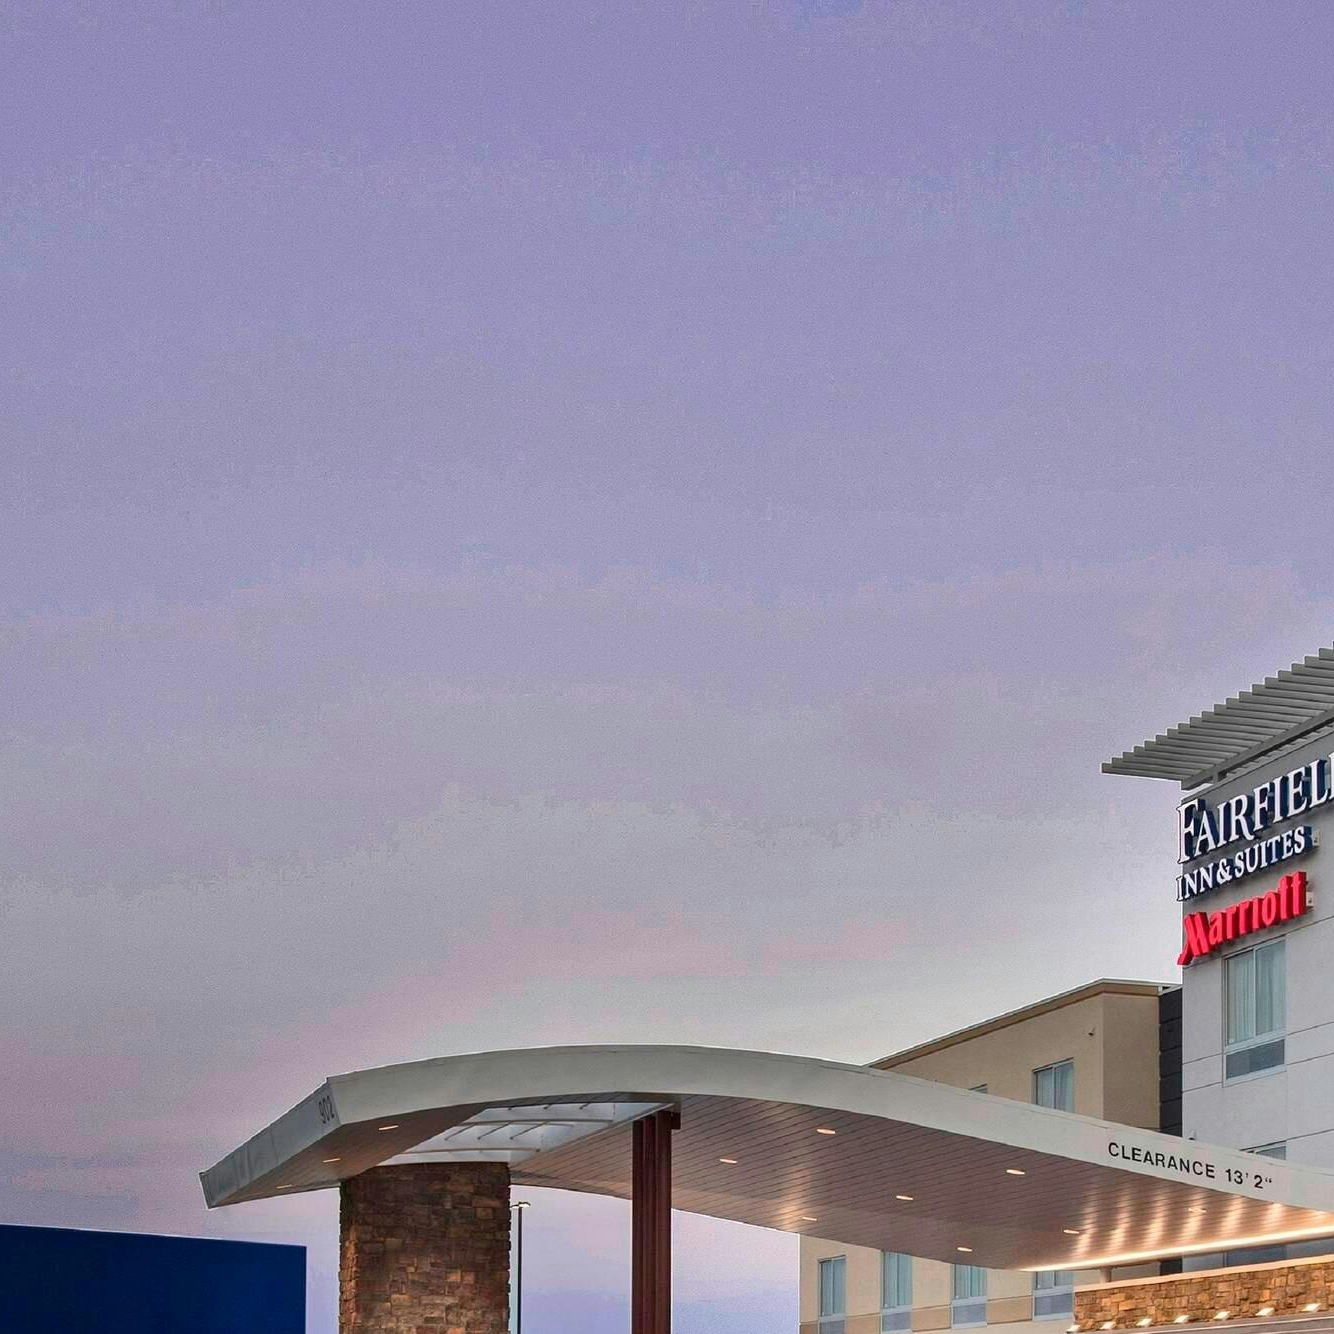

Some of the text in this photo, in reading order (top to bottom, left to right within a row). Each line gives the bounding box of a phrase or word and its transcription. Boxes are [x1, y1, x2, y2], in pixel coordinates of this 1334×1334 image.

[1234, 826, 1313, 880] SUITES
[1177, 871, 1308, 966] Marriott
[318, 1095, 335, 1124] 902
[1108, 1142, 1216, 1179] CLEARANCE
